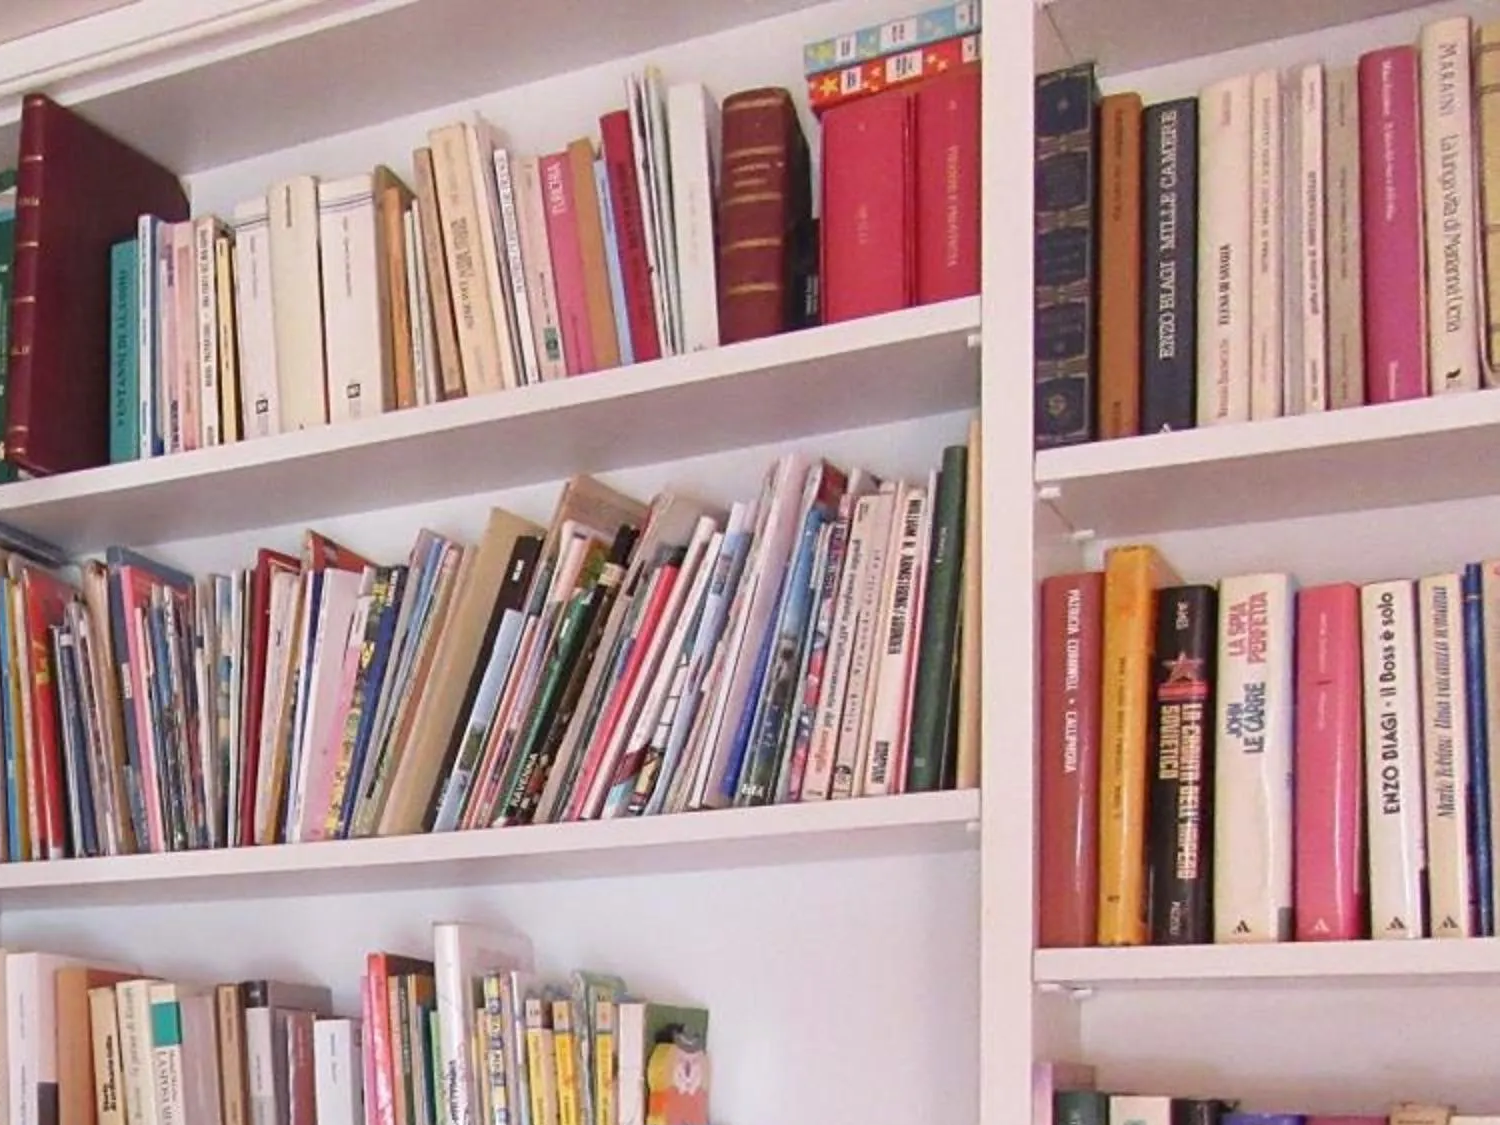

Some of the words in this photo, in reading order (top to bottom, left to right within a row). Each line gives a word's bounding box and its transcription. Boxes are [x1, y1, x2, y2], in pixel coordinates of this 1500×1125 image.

[1438, 44, 1459, 117] MARAINI
[1159, 111, 1177, 188] CAMERE
[1159, 193, 1176, 250] MILLE
[1159, 260, 1175, 309] BIAGI
[1159, 312, 1175, 358] ENZO
[902, 499, 922, 537] WILLIAM
[1066, 589, 1080, 635] PATRICIA
[1227, 603, 1247, 634] SPIA
[1247, 591, 1268, 663] PERFETTA
[1377, 592, 1394, 625] solo
[1065, 639, 1079, 691] CORNWELL
[1227, 637, 1244, 657] LA
[1379, 645, 1397, 681] Boss
[1159, 705, 1180, 780] SOVIETICO
[1225, 702, 1243, 739] JOHN
[1244, 736, 1266, 754] LE
[1380, 711, 1399, 760] BIAGI
[510, 753, 539, 807] RAVENNA
[1382, 765, 1401, 815] ENZO
